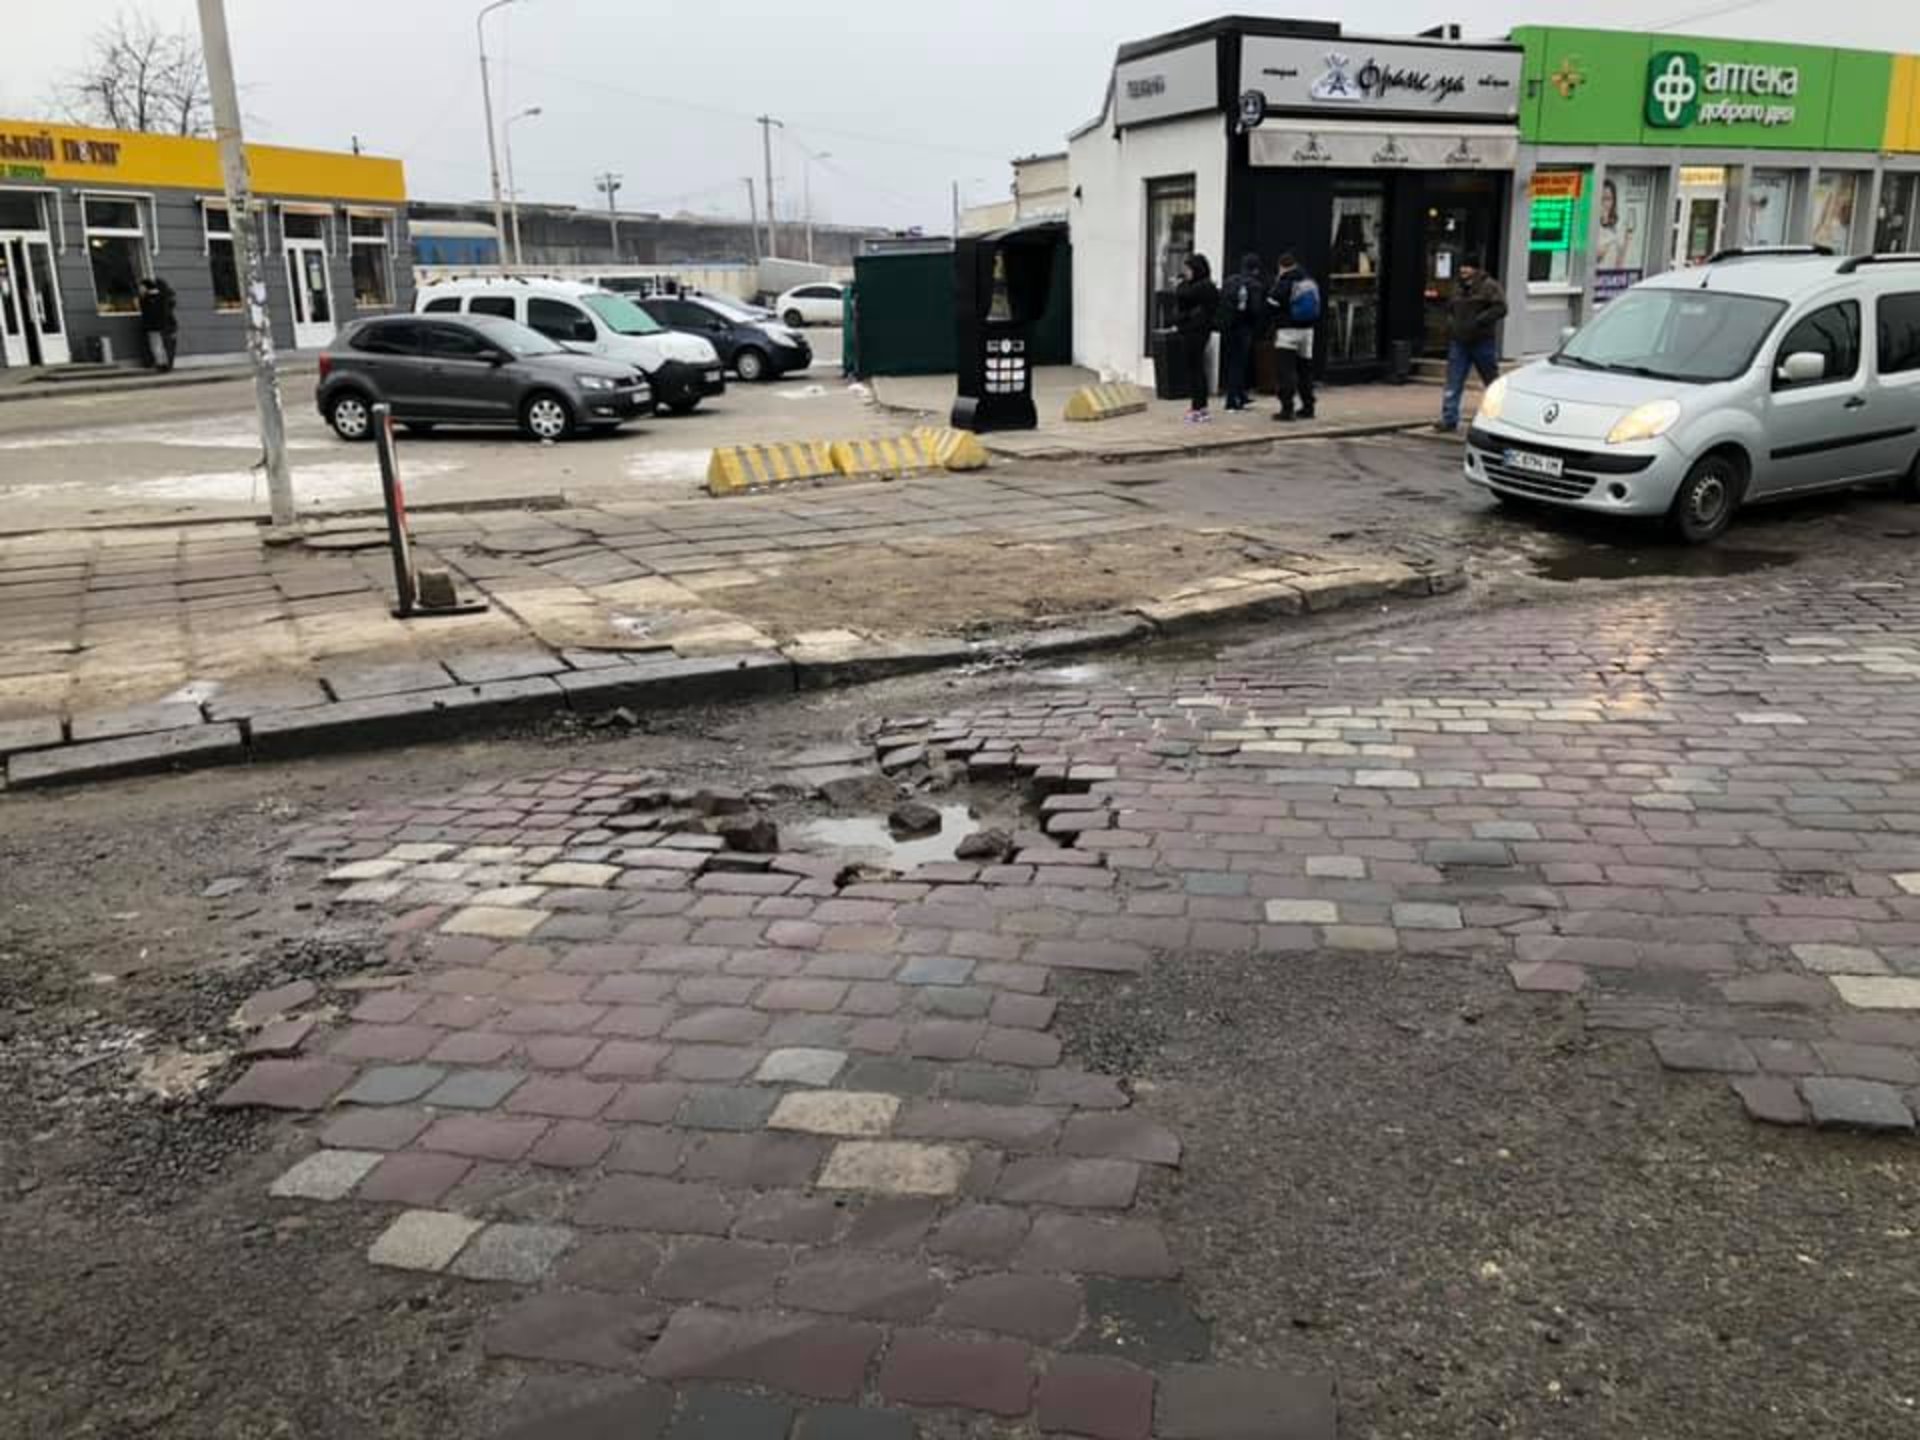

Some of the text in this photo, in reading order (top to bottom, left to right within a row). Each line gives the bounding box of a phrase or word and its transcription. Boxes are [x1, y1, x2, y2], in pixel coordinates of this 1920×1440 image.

[1704, 61, 1798, 96] аптека
[1698, 98, 1796, 126] доброго дня
